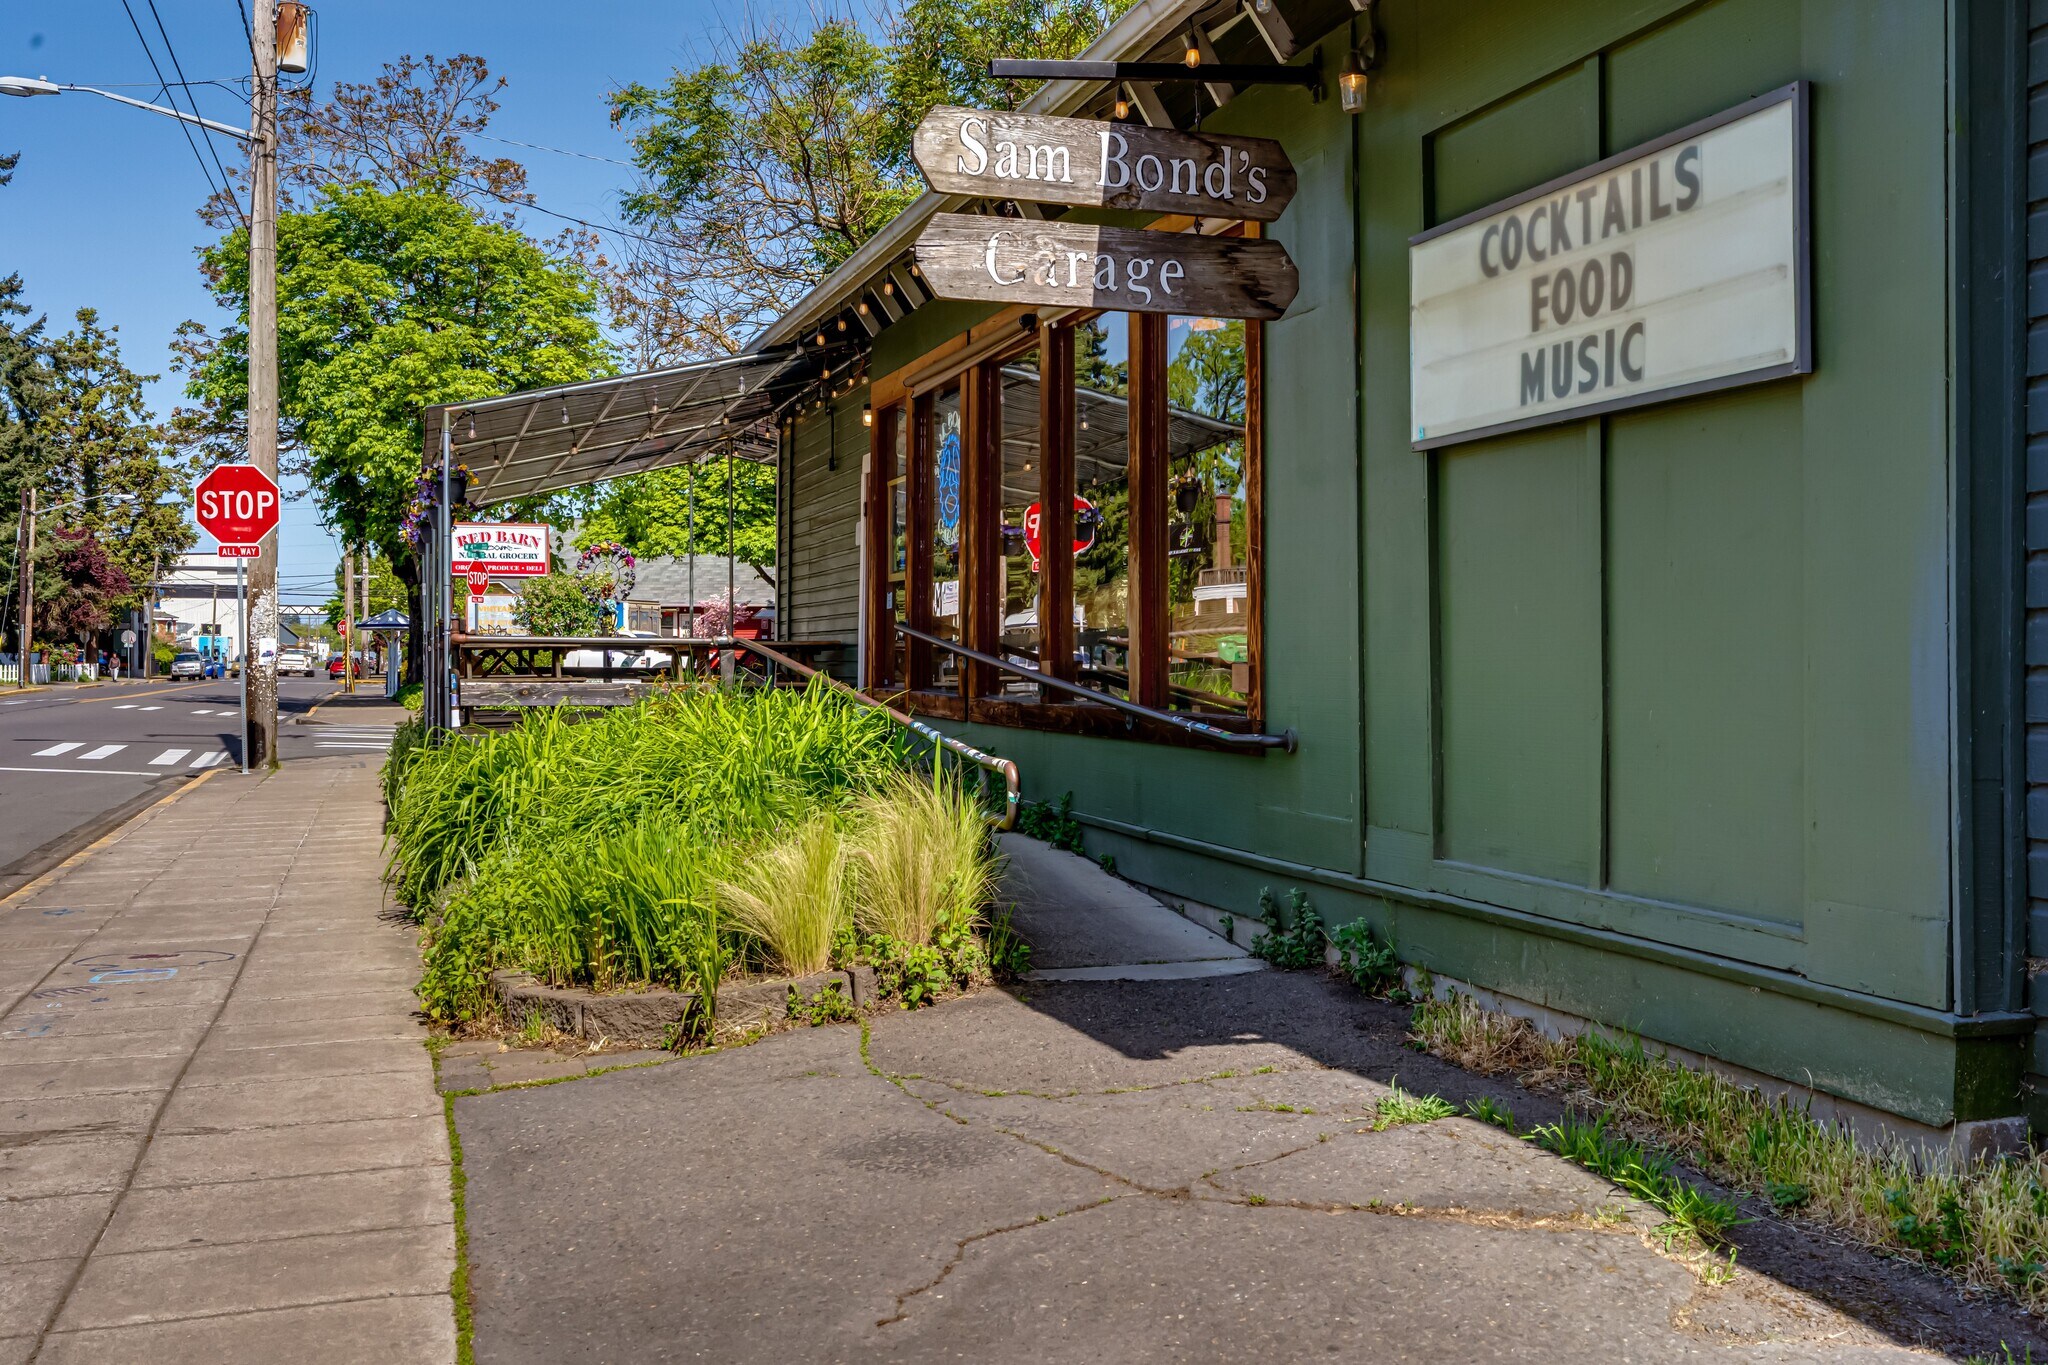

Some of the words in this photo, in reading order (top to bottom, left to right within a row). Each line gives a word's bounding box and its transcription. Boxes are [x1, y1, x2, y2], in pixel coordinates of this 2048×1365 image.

[957, 117, 1074, 184] Sam
[1095, 130, 1268, 204] Bond's
[1479, 145, 1701, 279] COCKTAILS
[1531, 251, 1634, 333] FOOD
[1519, 321, 1646, 407] MUSIC
[201, 490, 275, 520] STOP
[221, 547, 237, 556] ALL
[239, 547, 257, 556] WAY
[455, 532, 492, 548] RED
[495, 531, 541, 550] BARN
[499, 552, 539, 560] GROCERY
[468, 572, 487, 586] STOP
